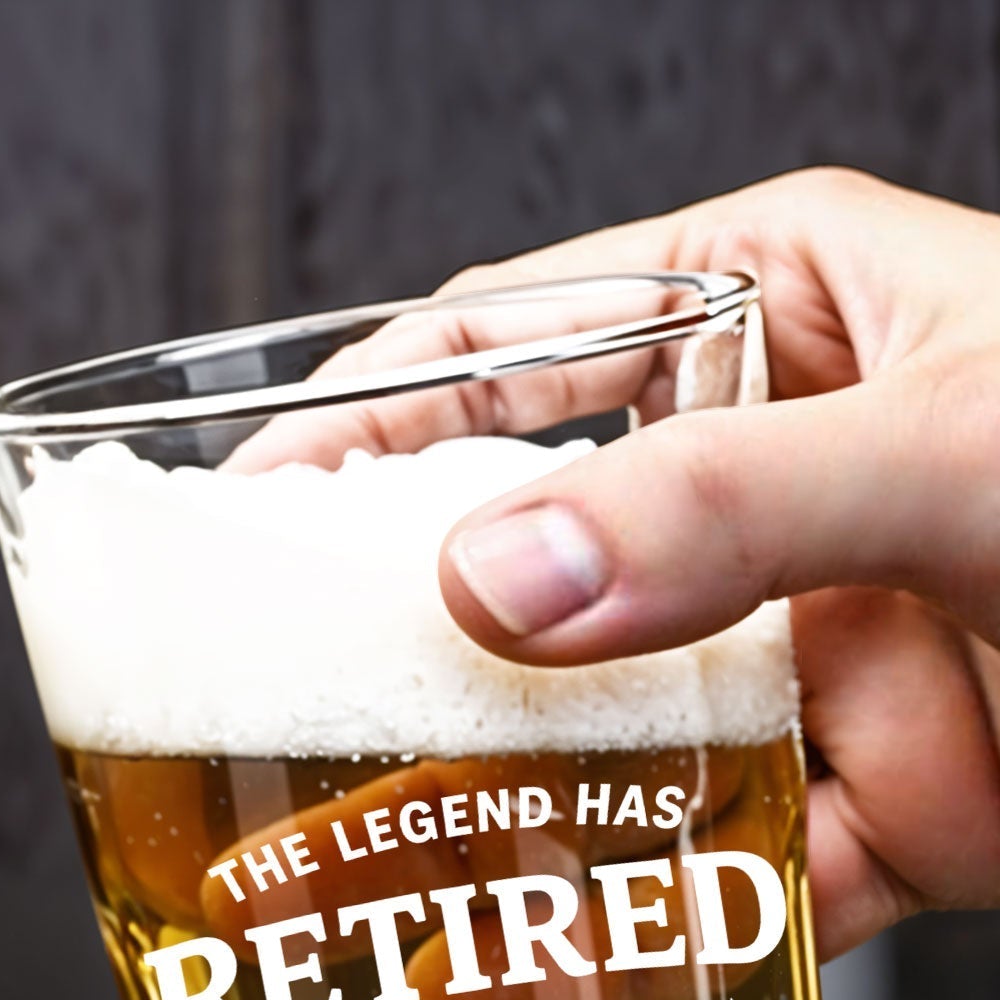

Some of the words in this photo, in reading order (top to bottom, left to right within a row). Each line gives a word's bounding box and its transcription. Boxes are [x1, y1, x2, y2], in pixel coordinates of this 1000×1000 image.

[207, 831, 320, 903] THE
[330, 786, 554, 862] LEGEND
[575, 783, 686, 829] HAS
